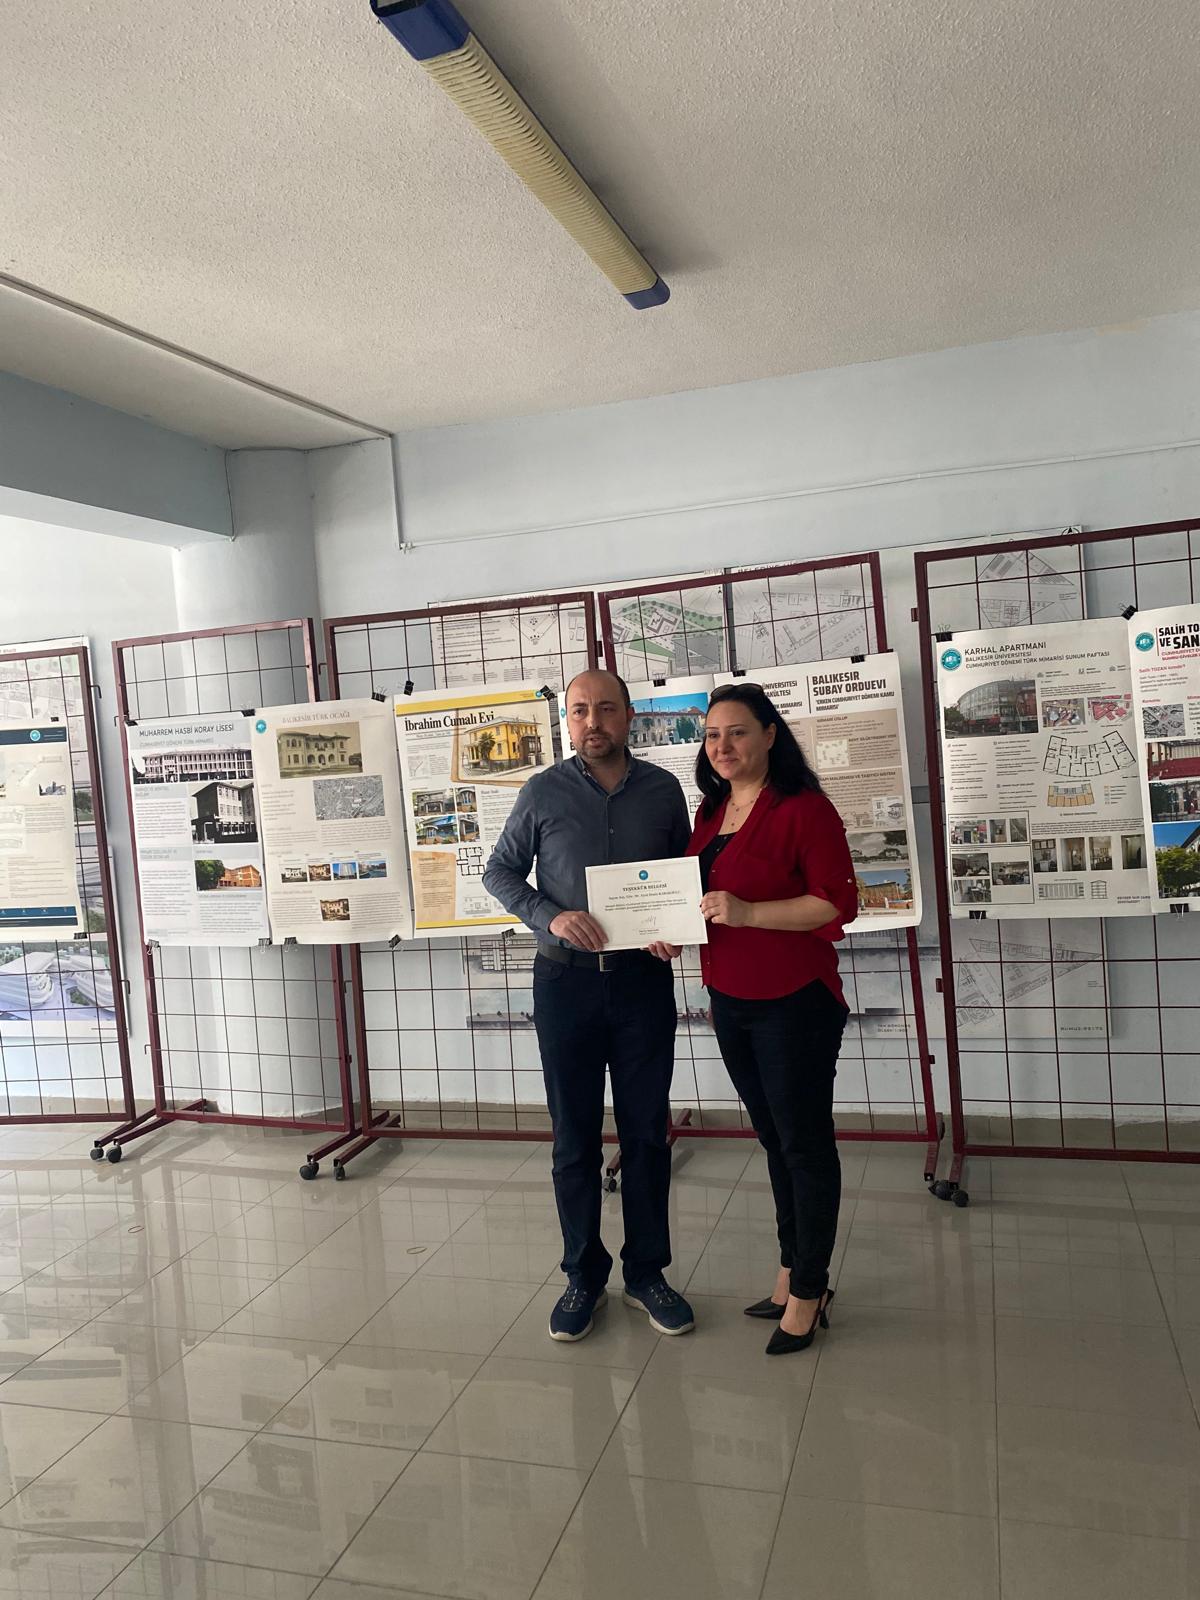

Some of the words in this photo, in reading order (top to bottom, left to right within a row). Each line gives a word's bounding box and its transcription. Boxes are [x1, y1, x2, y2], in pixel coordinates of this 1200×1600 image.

[1159, 624, 1185, 636] SALİH
[964, 646, 998, 655] KARHAL
[1000, 642, 1046, 651] APARTMANI
[1160, 638, 1172, 647] VE
[994, 651, 1032, 659] ÜNİVERSİTESİ
[813, 684, 843, 696] SUBAY
[405, 717, 442, 731] İbrahim
[443, 713, 477, 727] Cumalı
[478, 711, 494, 724] Evi
[140, 728, 173, 737] MUHARREM
[175, 726, 192, 735] HASBİ
[194, 725, 214, 733] KORAY
[216, 724, 234, 732] LİSESİ
